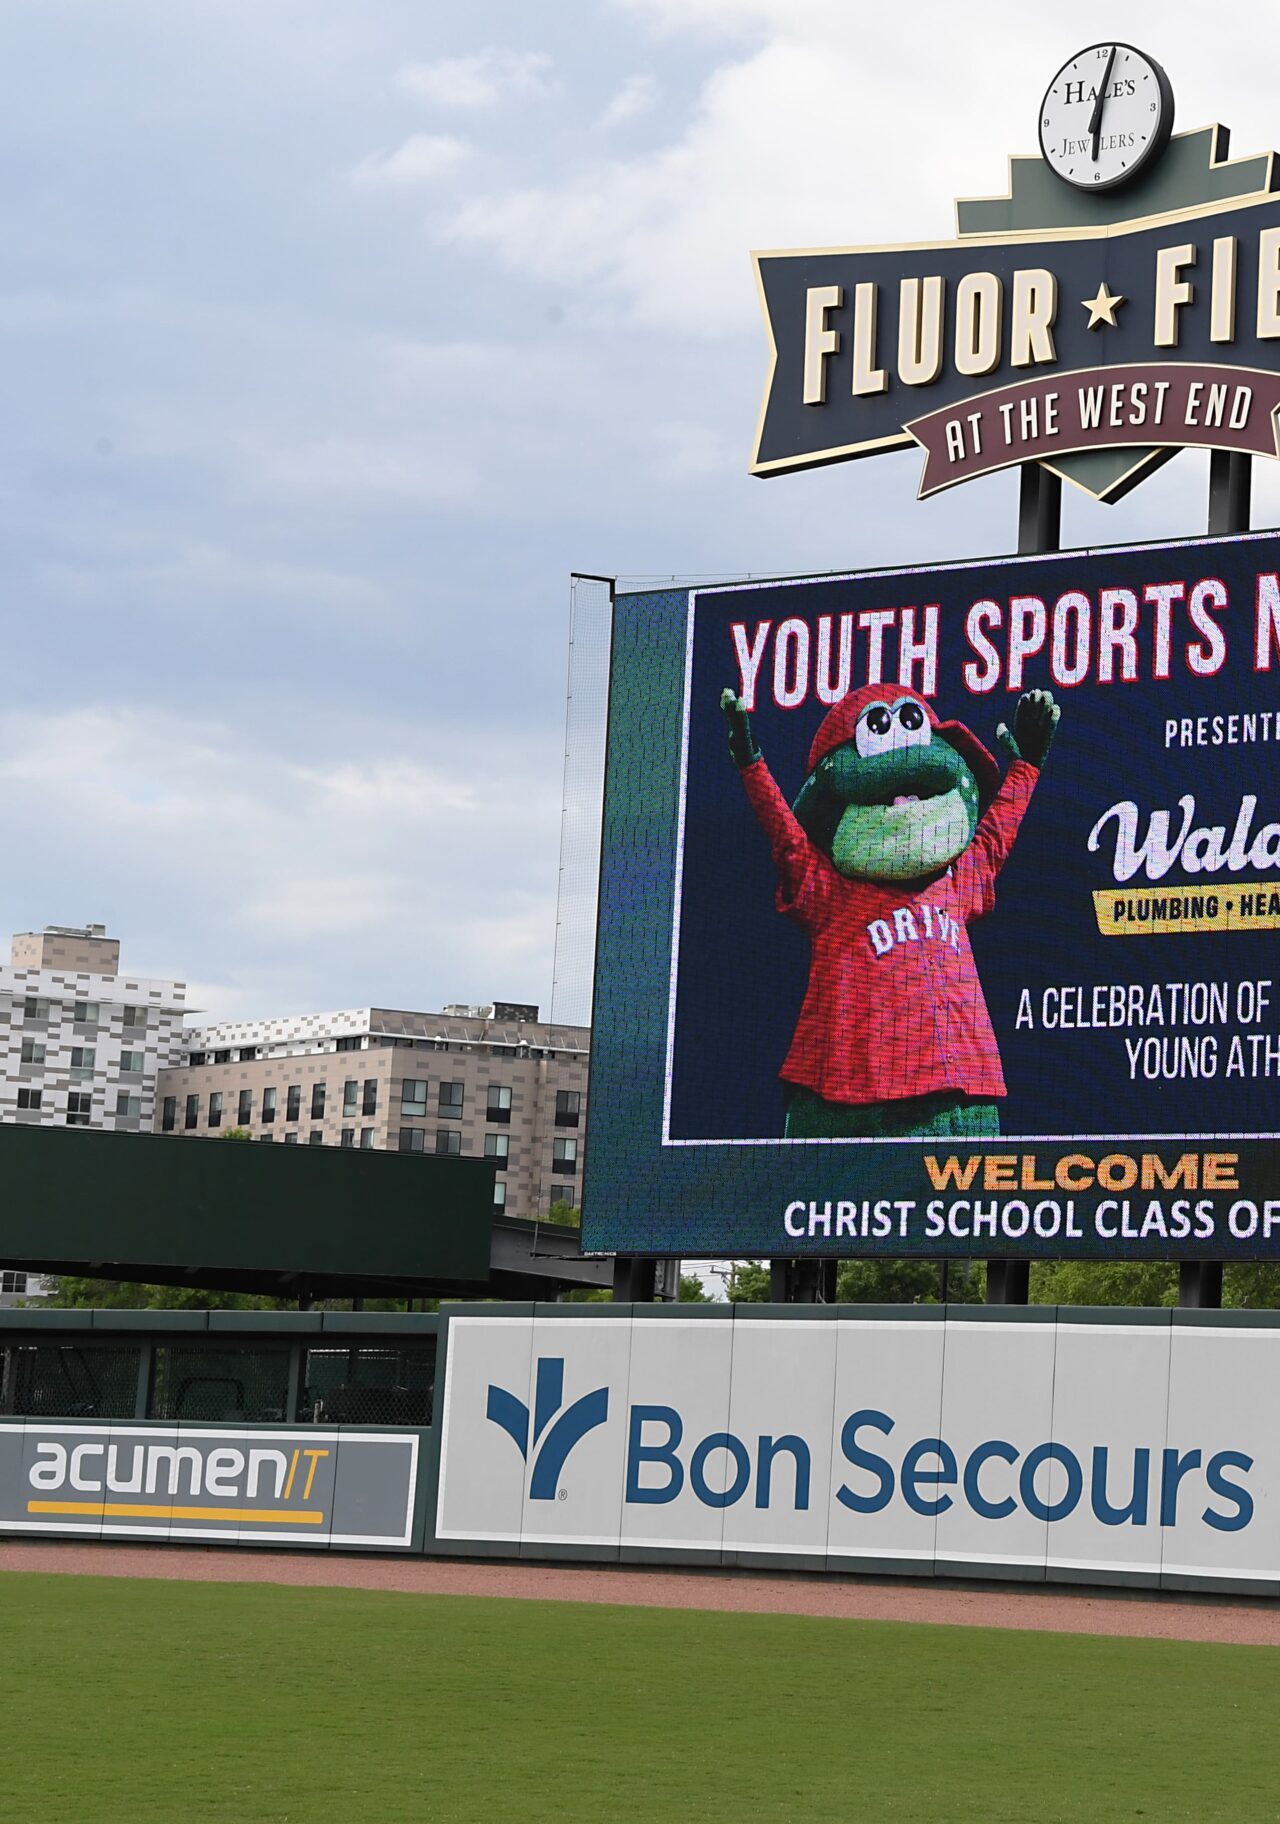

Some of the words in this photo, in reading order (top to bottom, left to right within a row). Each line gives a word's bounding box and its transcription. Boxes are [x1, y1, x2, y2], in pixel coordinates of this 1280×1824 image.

[1096, 49, 1109, 59] 12
[1043, 118, 1050, 128] 9
[1150, 103, 1156, 112] 3
[1059, 133, 1135, 158] JEWLERS
[1094, 172, 1100, 181] 6
[803, 268, 1058, 406] FLUOR
[945, 412, 983, 463] AT
[999, 393, 1060, 445] THE
[1078, 382, 1170, 430] WEST
[1184, 382, 1253, 430] END
[730, 604, 941, 712] YOUTH
[962, 577, 1228, 696] SPORTS
[1112, 890, 1219, 922] PLUMBING
[1015, 988, 1034, 1030] A
[1042, 980, 1228, 1030] CELEBRATION
[1236, 980, 1272, 1024] OF
[1124, 1035, 1218, 1080] YOUNG
[923, 1153, 1240, 1191] WELCOME
[784, 1200, 916, 1237] CHRIST
[924, 1200, 1083, 1238] SCHOOL
[1094, 1199, 1215, 1239] CLASS
[625, 1405, 811, 1510] Bon
[836, 1409, 1254, 1532] Secours
